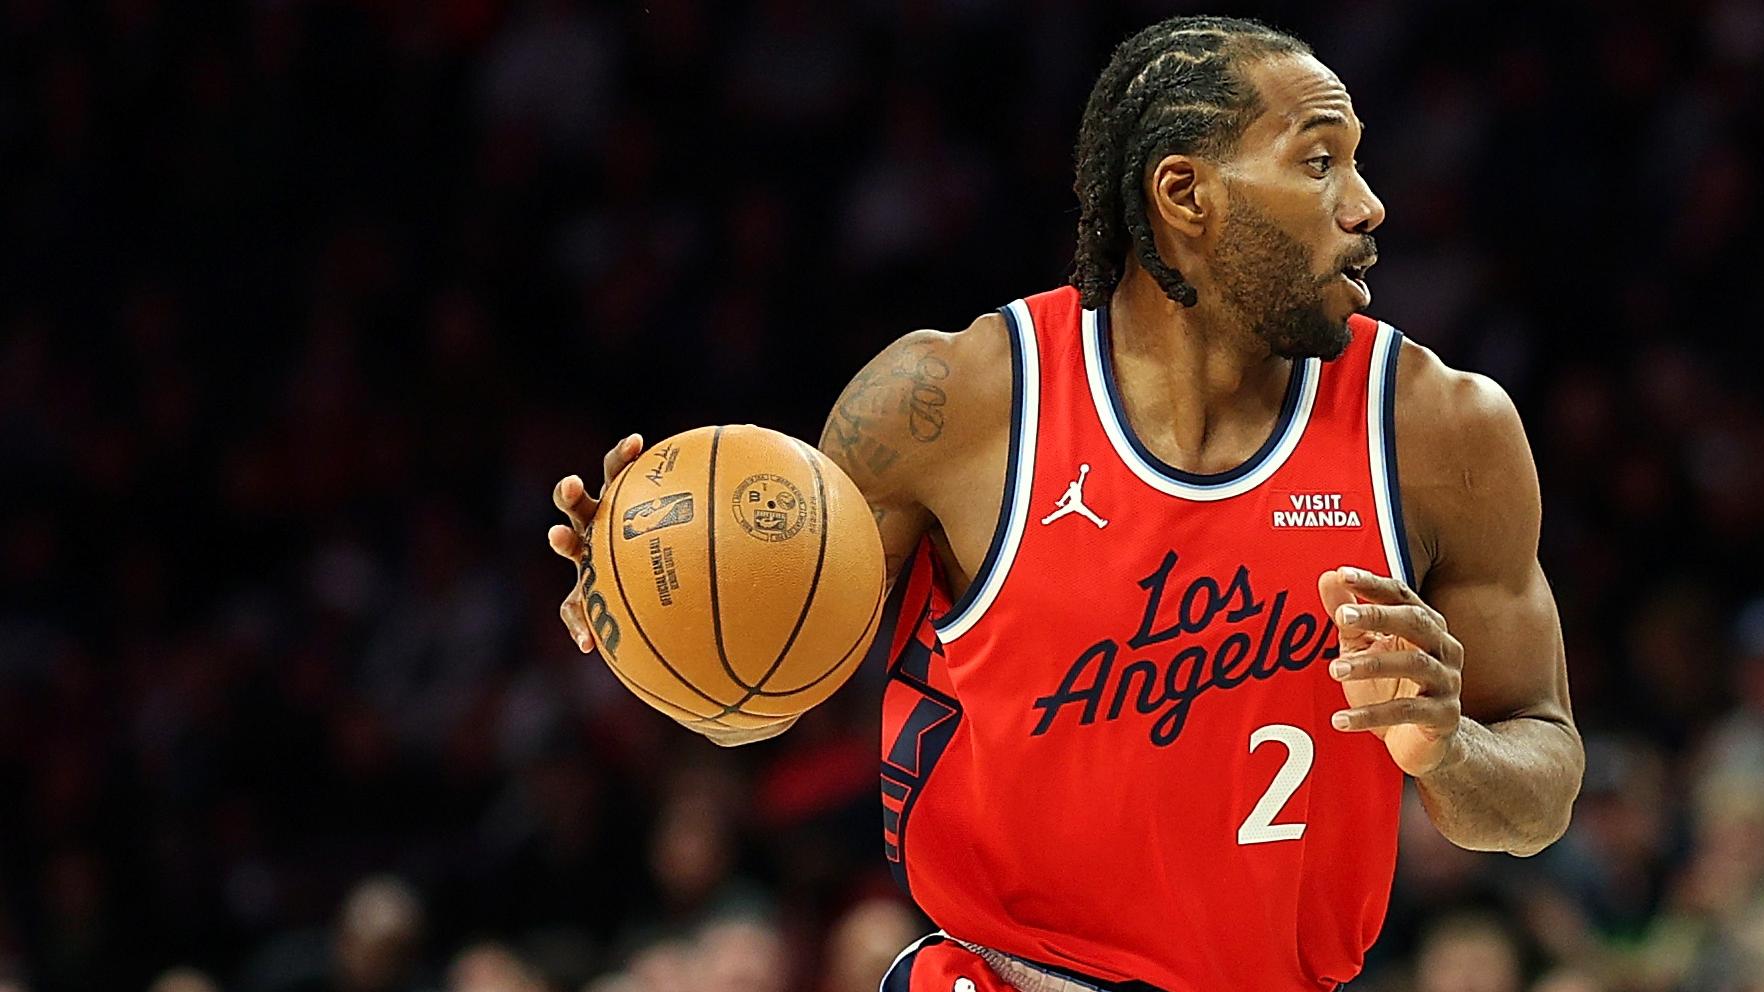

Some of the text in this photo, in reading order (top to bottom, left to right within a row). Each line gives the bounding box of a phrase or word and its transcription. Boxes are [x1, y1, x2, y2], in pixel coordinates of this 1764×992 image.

[1273, 511, 1362, 527] RWANDA
[1289, 494, 1342, 510] VISIT
[649, 537, 673, 606] OFFICIAL GAME BALL
[1127, 549, 1262, 651] Los
[1237, 723, 1316, 845] 2
